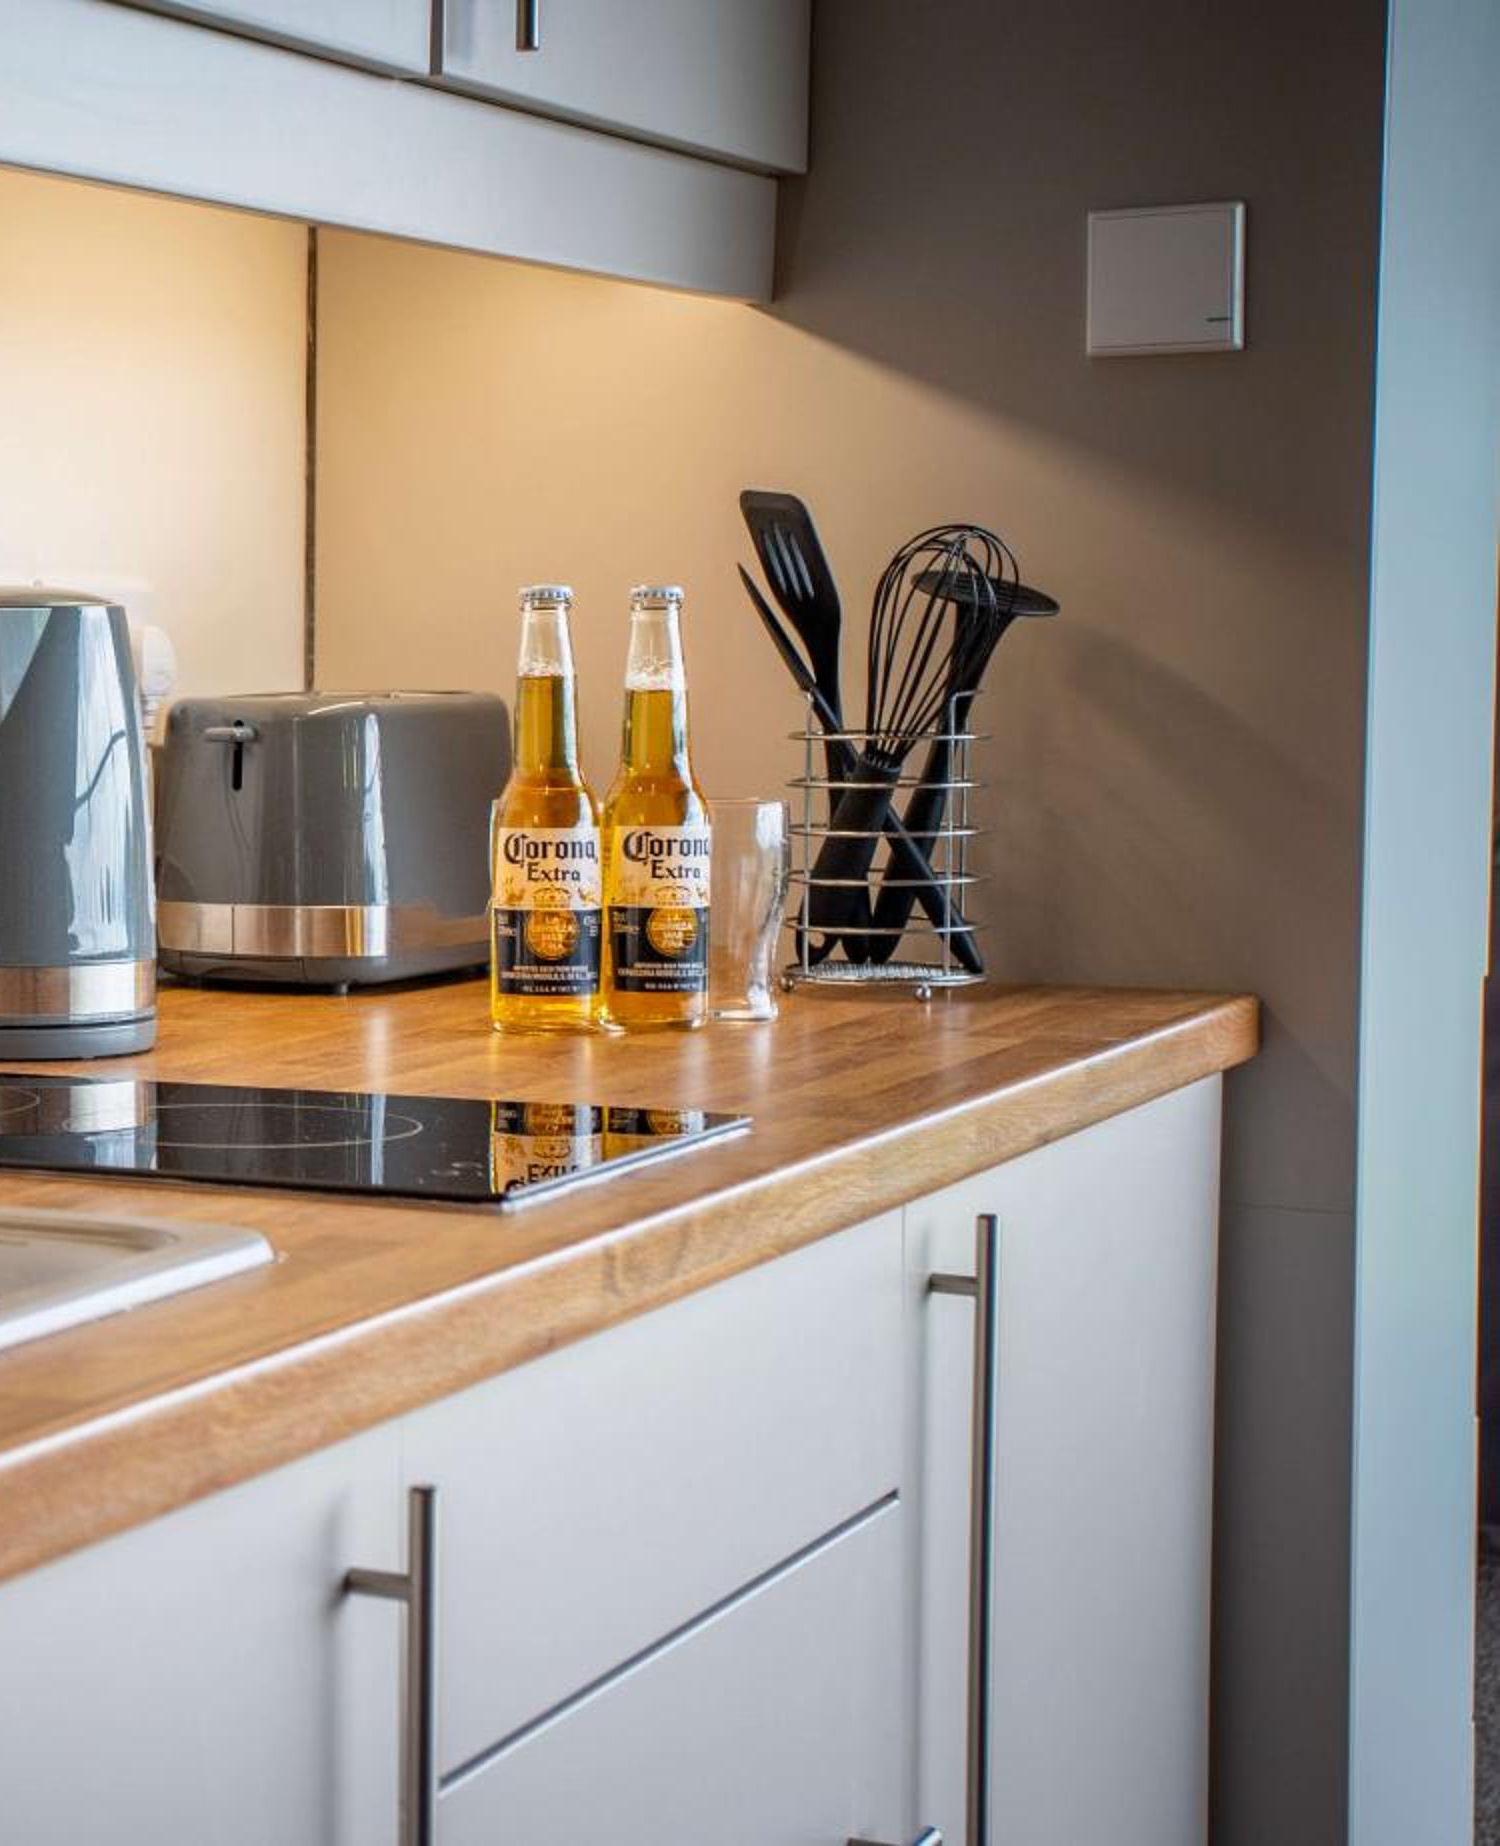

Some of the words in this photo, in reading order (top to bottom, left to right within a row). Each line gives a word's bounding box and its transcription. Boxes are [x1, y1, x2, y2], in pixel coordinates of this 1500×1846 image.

[504, 833, 597, 867] Corona
[527, 862, 581, 882] Extra
[651, 860, 701, 880] Extra
